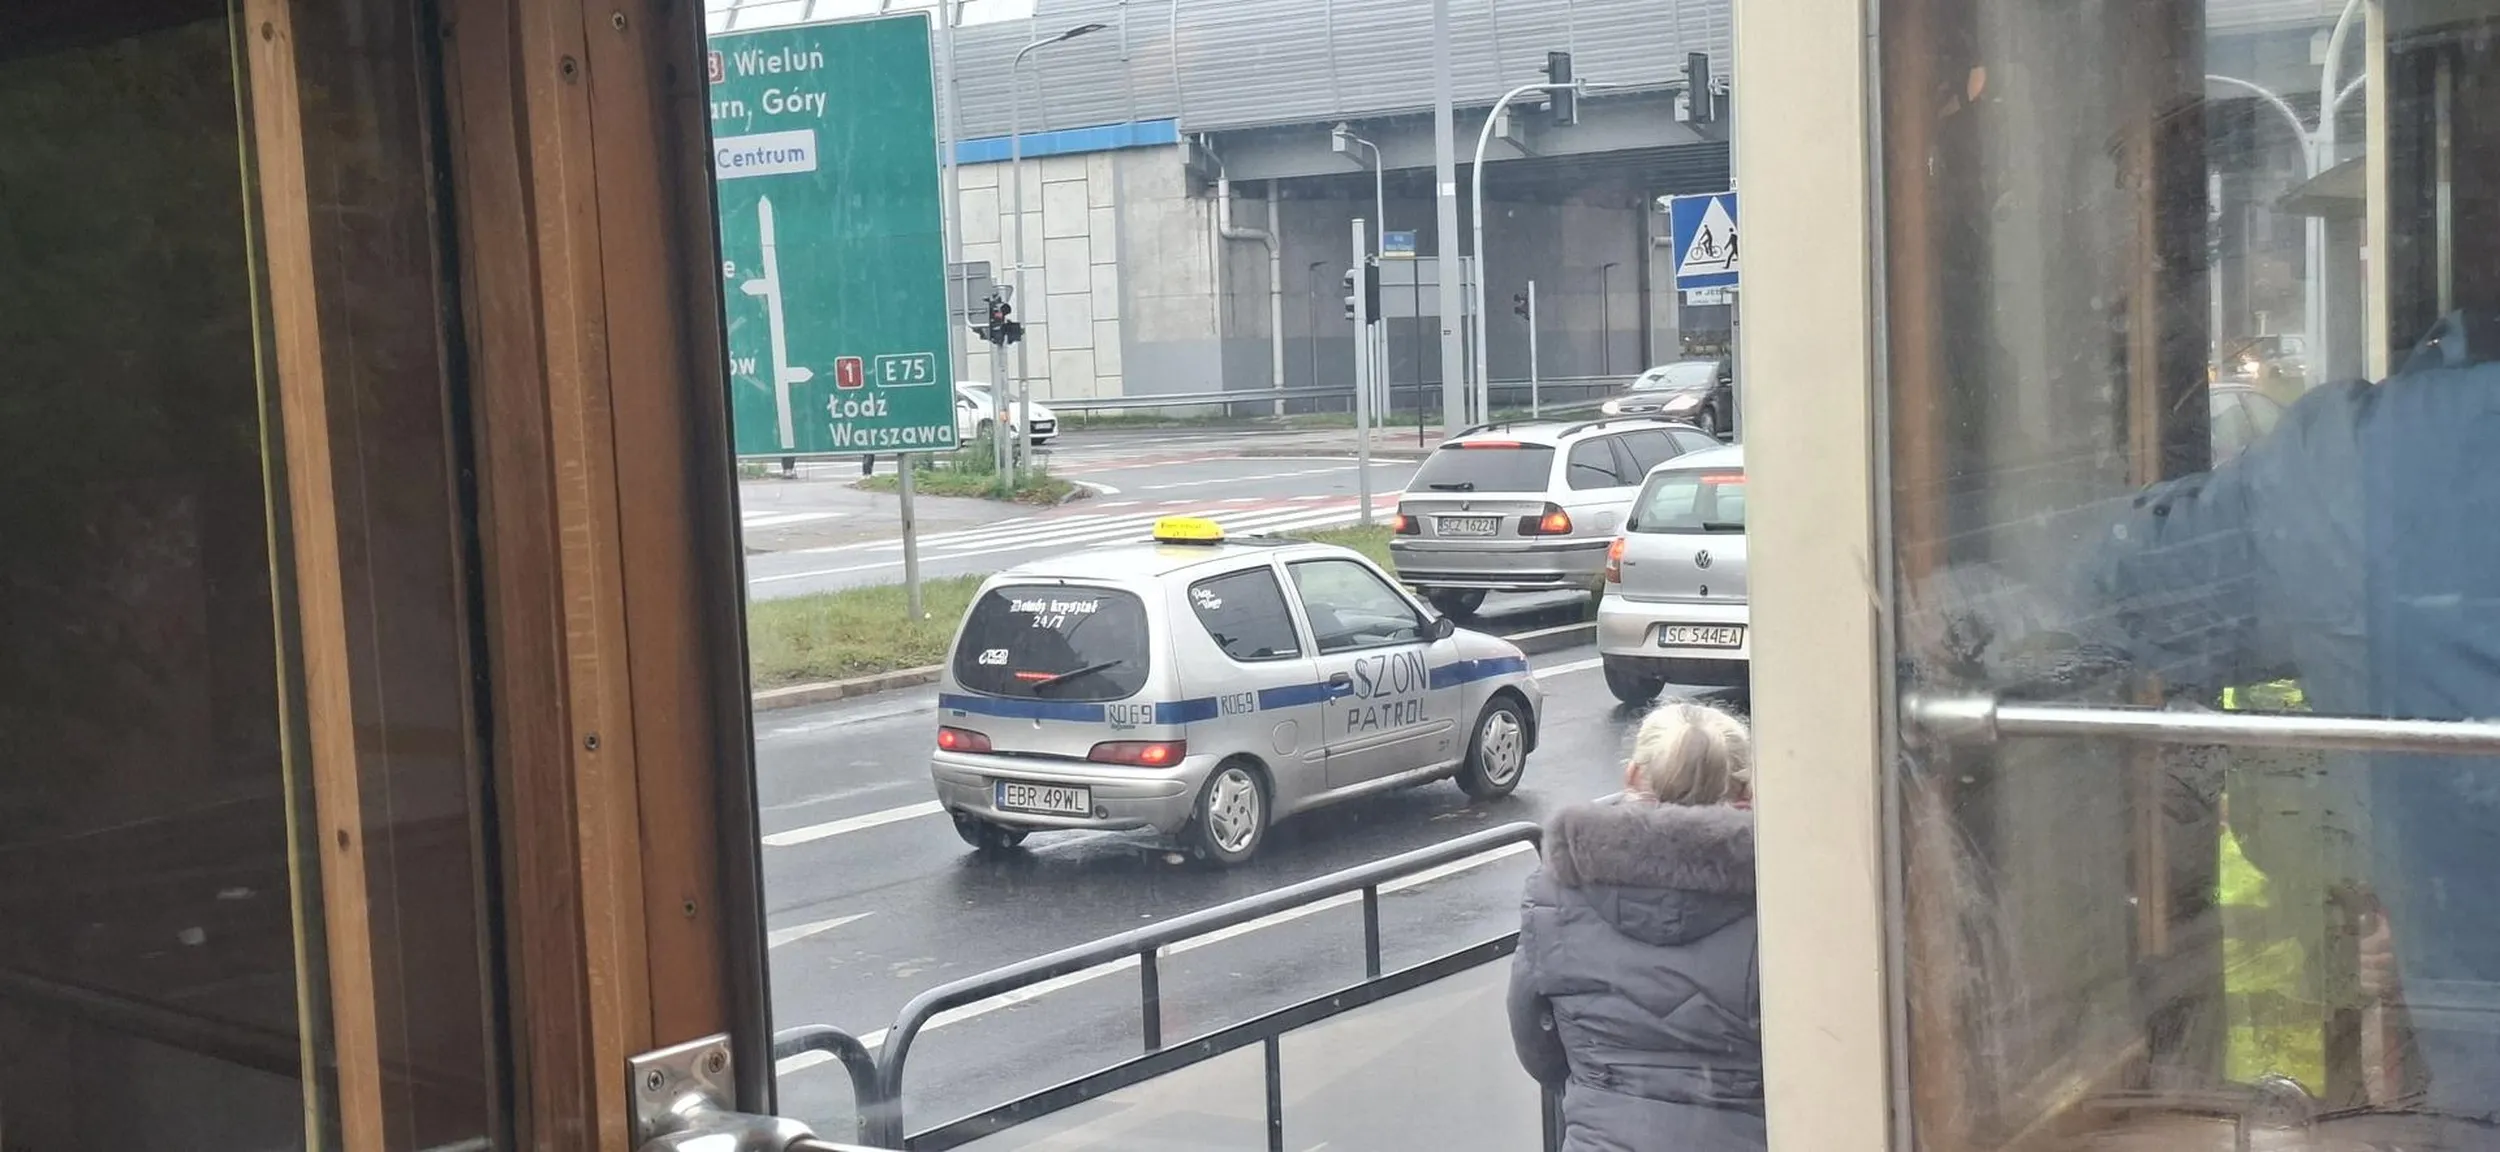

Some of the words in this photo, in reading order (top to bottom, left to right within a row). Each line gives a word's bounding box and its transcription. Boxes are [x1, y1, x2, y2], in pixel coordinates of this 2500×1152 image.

[734, 43, 824, 76] Wieluń
[762, 87, 826, 118] Góry
[717, 147, 805, 168] Centrum
[845, 362, 853, 384] 1
[885, 361, 897, 381] E
[901, 359, 925, 380] 75
[826, 391, 887, 419] Łódź
[828, 422, 953, 447] Warszawa
[1465, 520, 1495, 532] 1622A
[1031, 614, 1065, 628] 24/7
[1668, 627, 1686, 642] SC
[1691, 627, 1738, 644] 544EA
[1347, 697, 1430, 734] PATROL
[1007, 785, 1037, 806] EBR
[1043, 788, 1084, 811] 49WL
